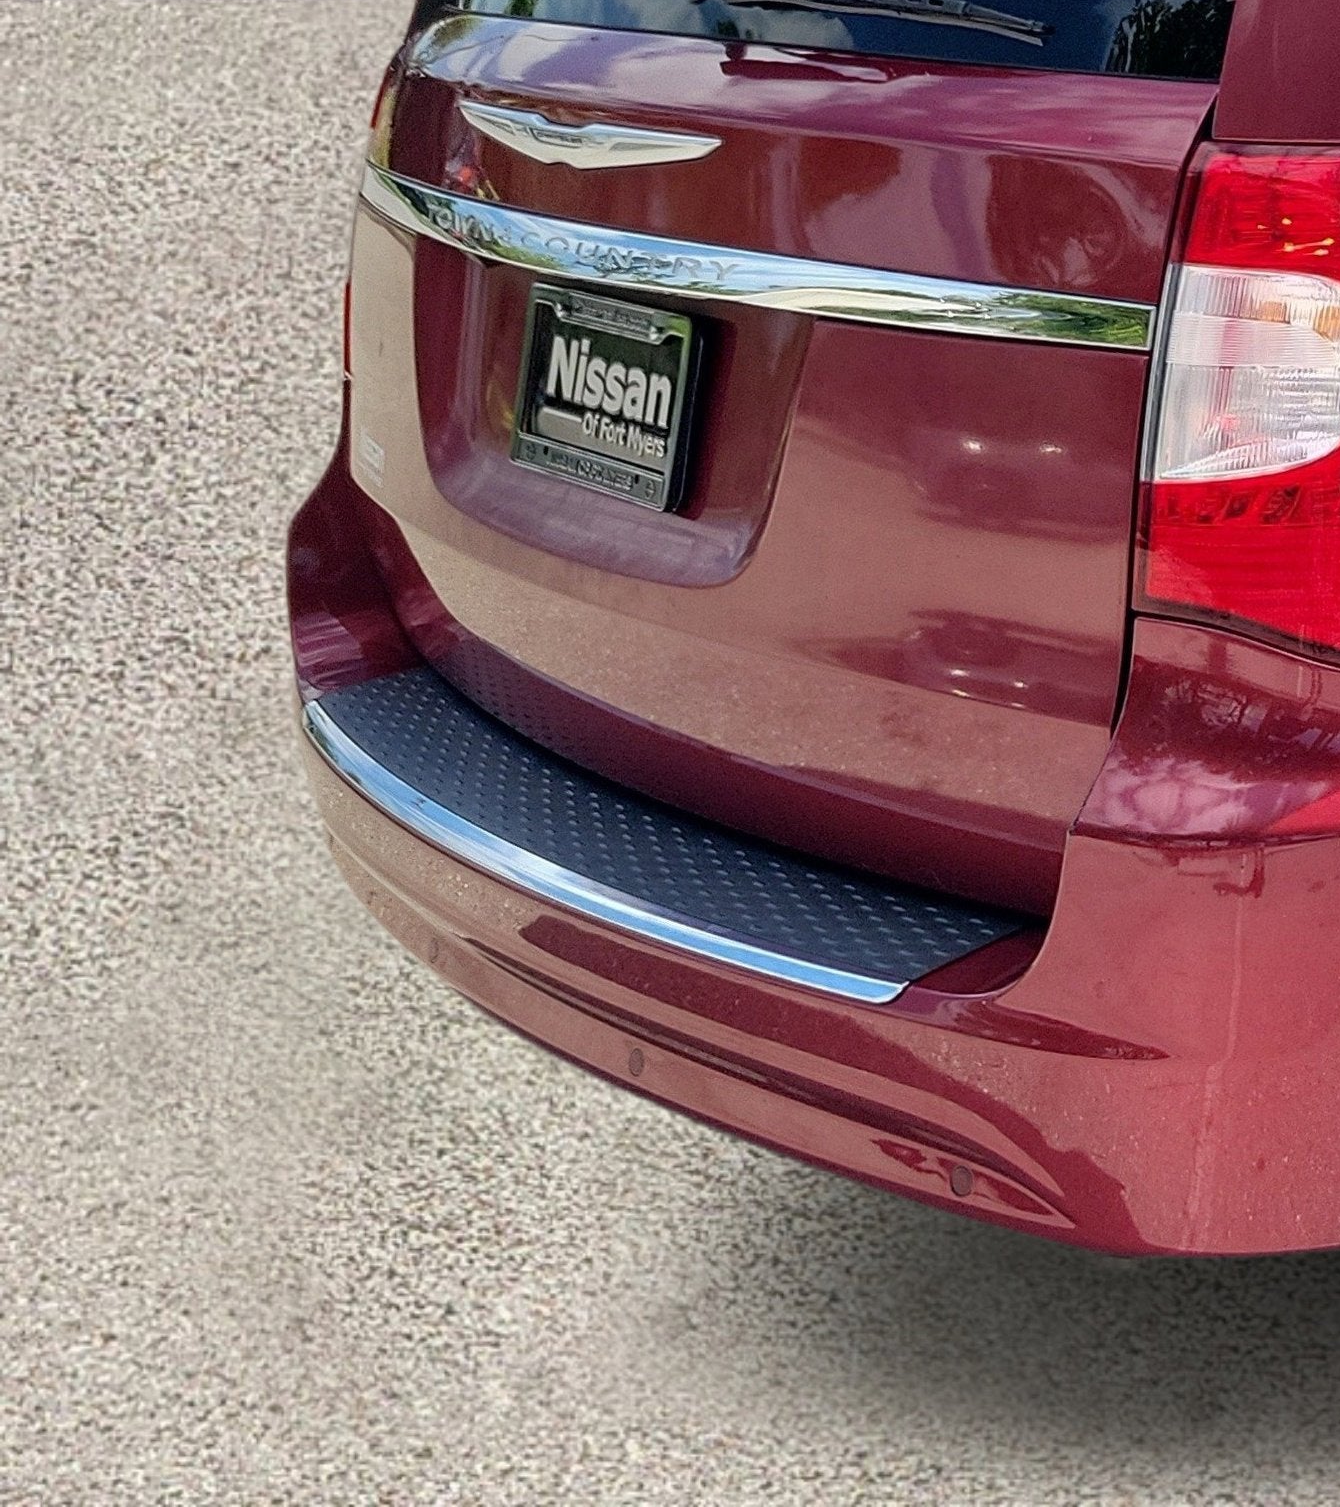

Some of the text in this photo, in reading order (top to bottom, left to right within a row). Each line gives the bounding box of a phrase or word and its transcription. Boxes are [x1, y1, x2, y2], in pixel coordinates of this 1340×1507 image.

[426, 201, 495, 243] TOWN
[519, 230, 743, 281] COUNTRY
[547, 335, 672, 429] Nissan
[599, 415, 628, 445] Fort
[627, 424, 666, 458] Myers
